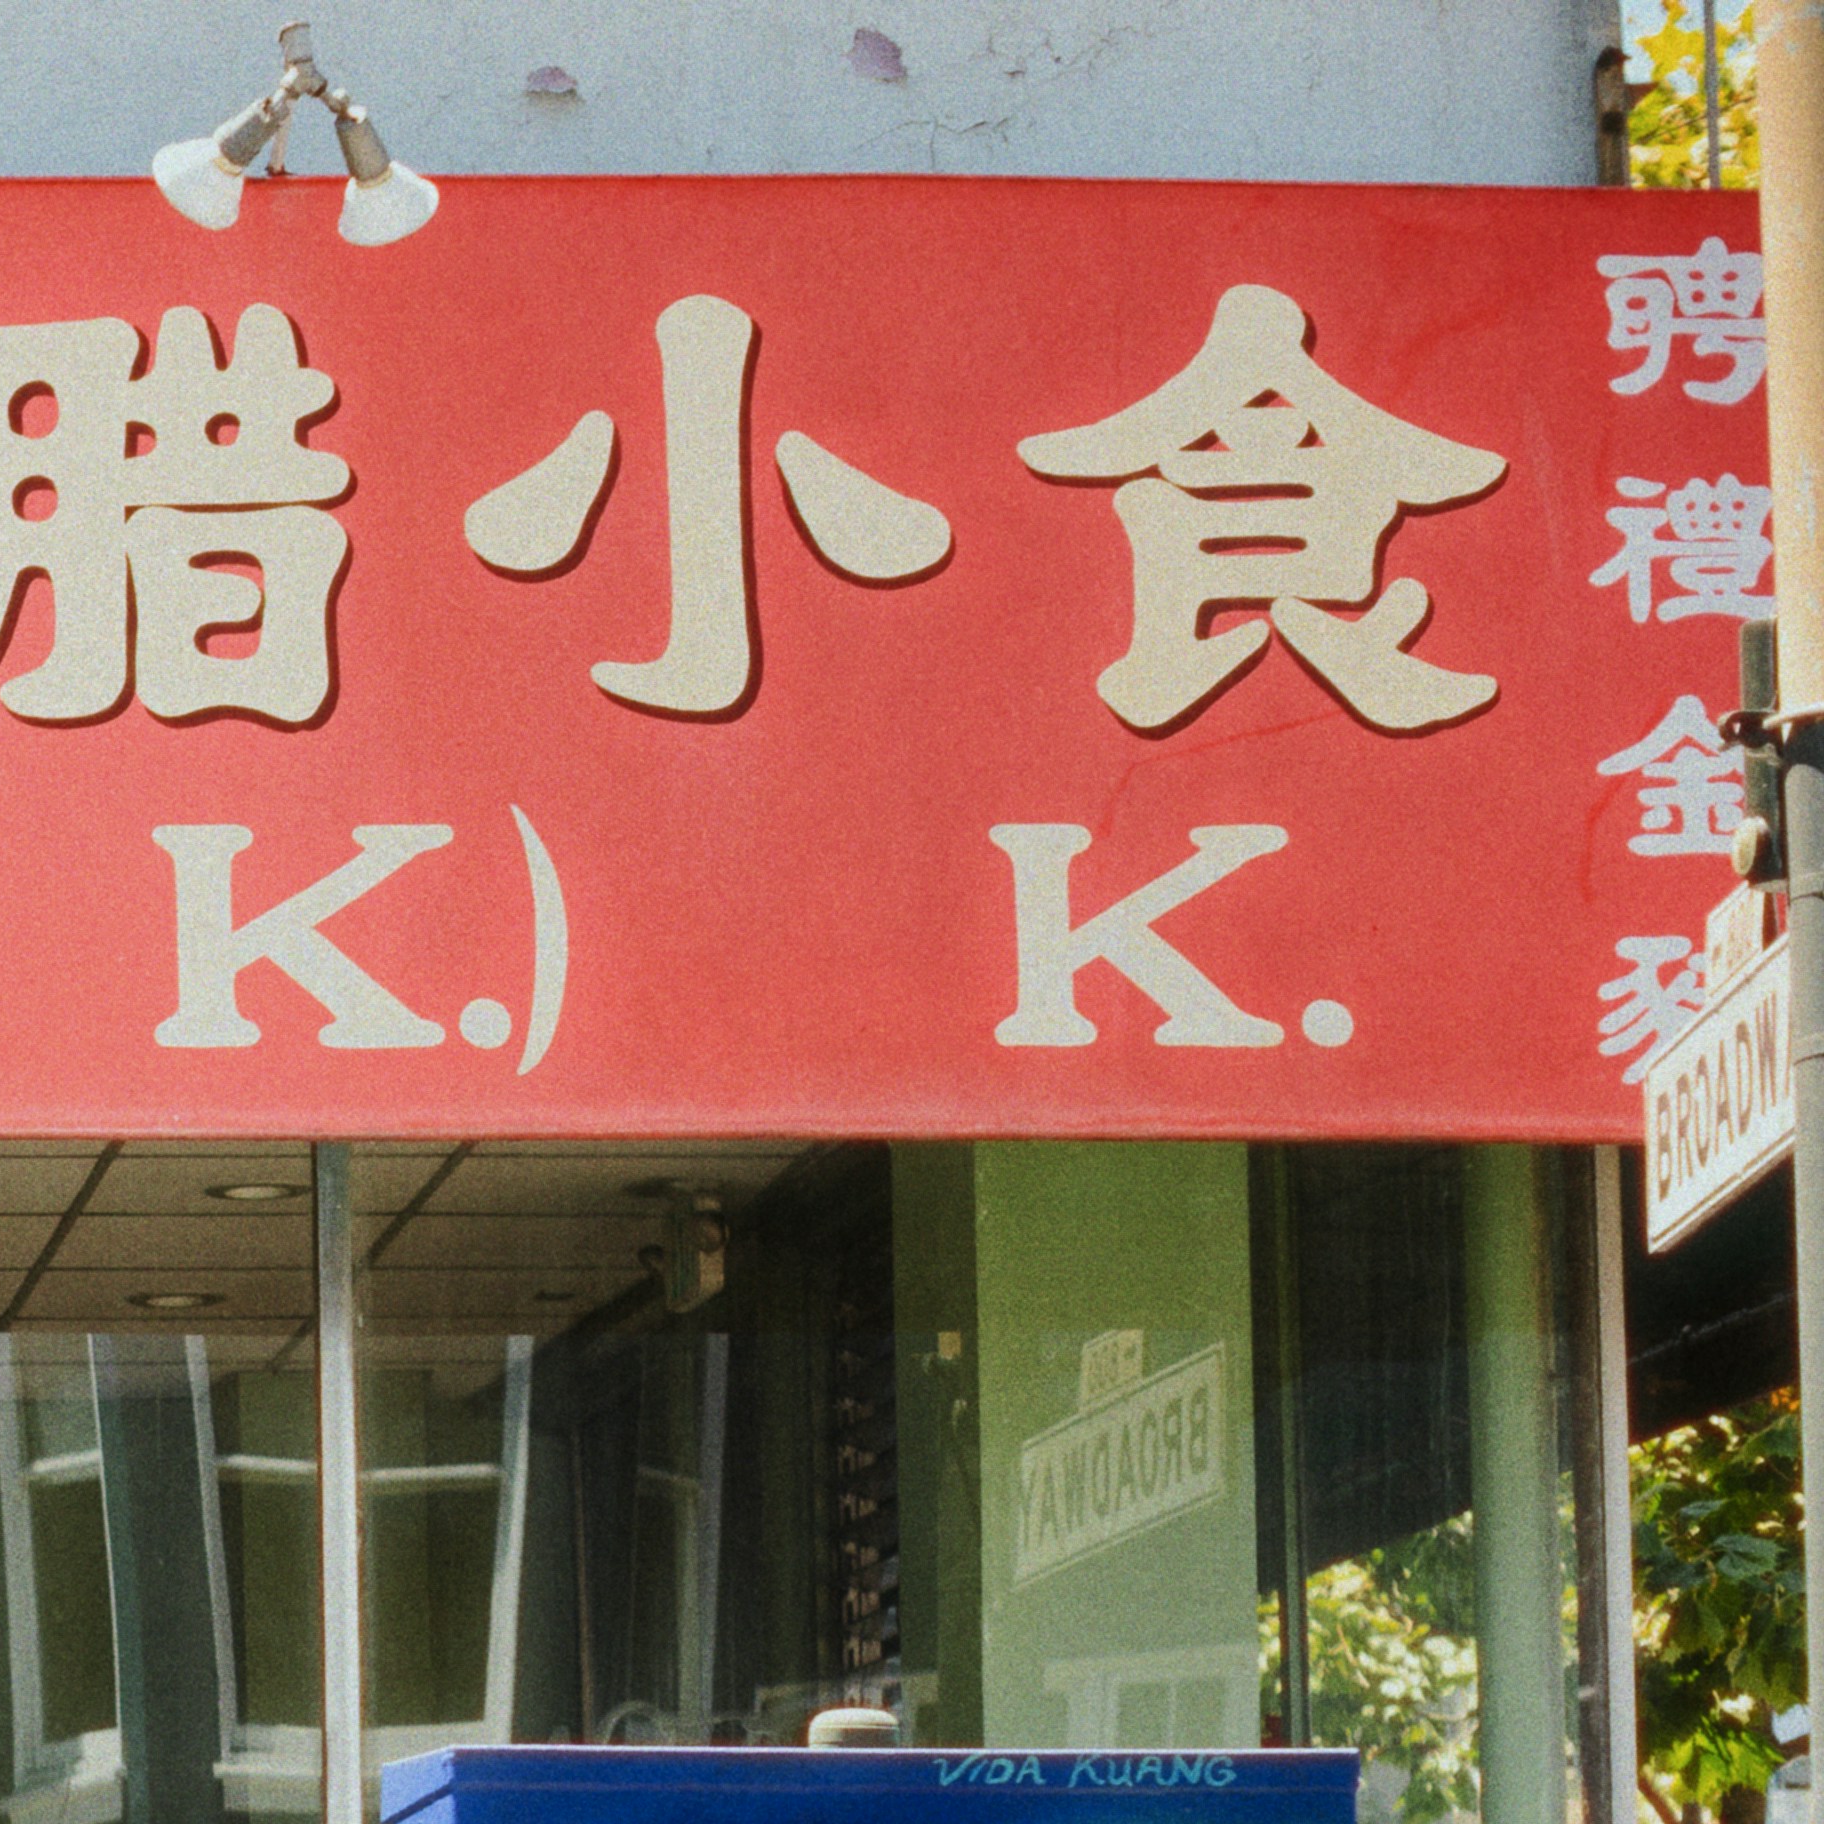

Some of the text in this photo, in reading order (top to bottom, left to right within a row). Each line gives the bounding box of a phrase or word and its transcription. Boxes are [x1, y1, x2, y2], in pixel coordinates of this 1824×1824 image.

[151, 804, 569, 1077] K.)
[989, 822, 1354, 1049] K.
[932, 1753, 1238, 1789] VIDA KUANG
